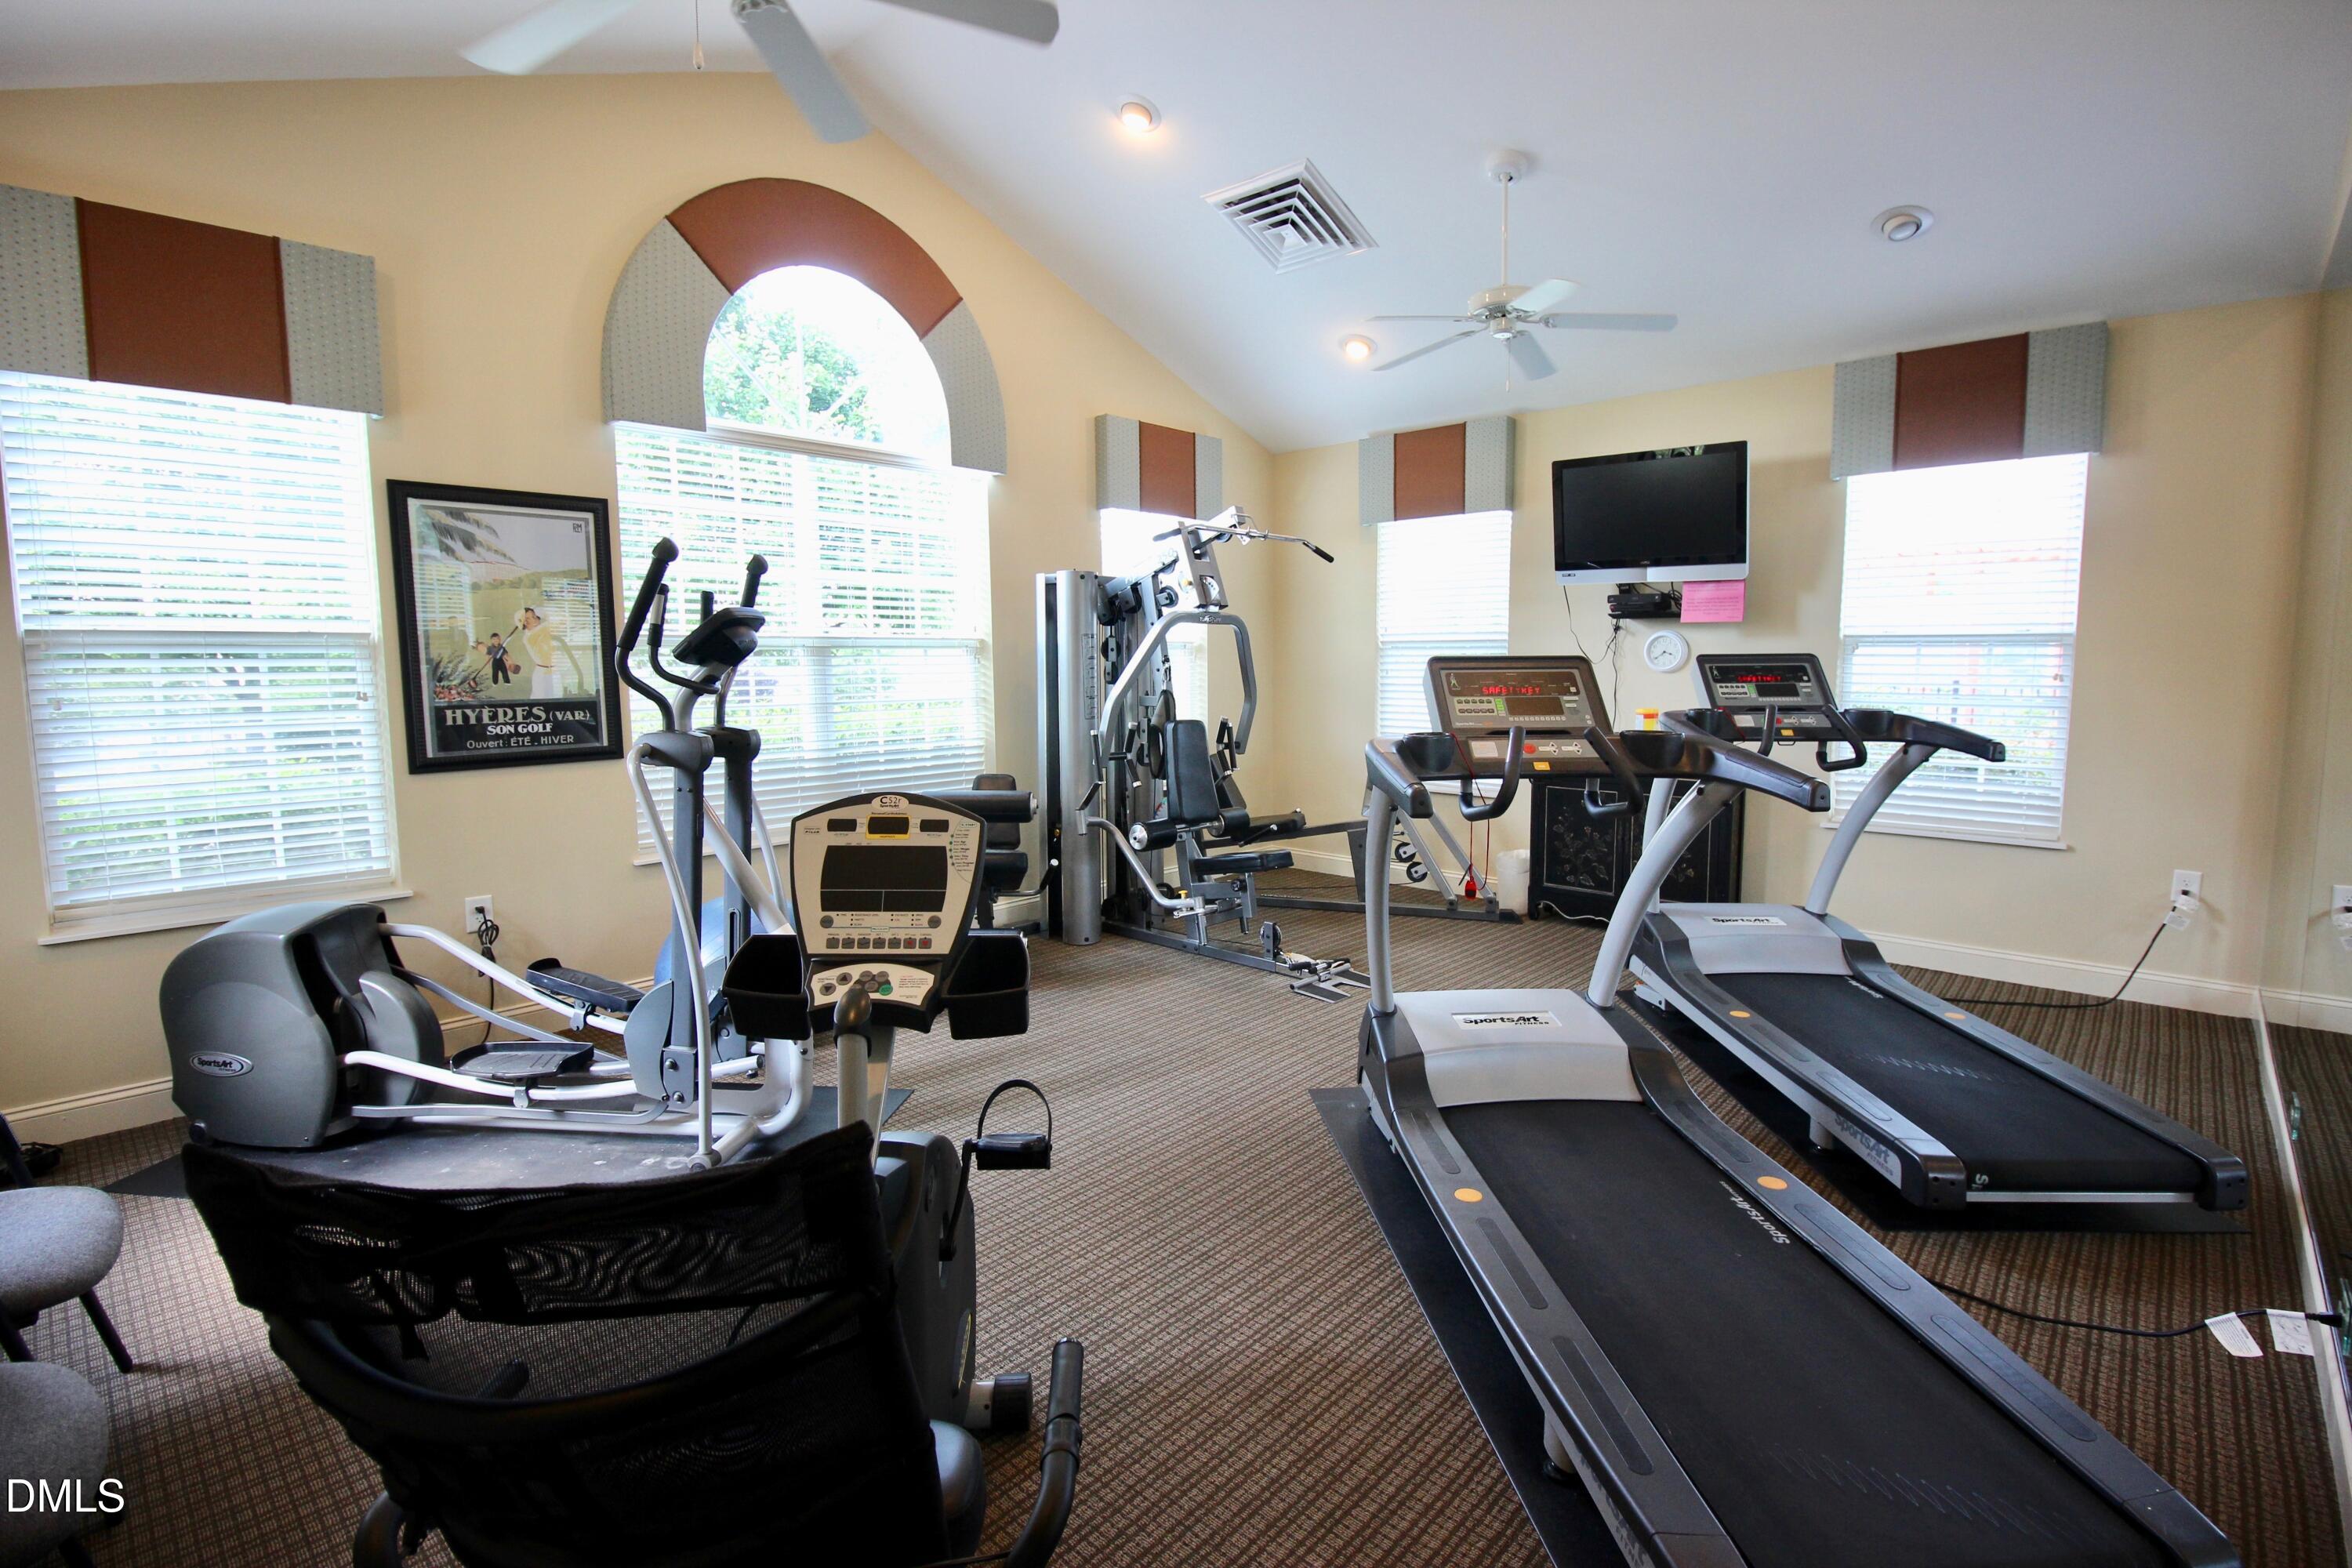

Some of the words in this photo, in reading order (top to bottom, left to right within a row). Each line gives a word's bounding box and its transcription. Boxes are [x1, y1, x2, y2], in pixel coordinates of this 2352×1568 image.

[445, 706, 547, 726] HYÈRES
[550, 709, 590, 721] (VAR)
[486, 724, 515, 735] SON
[517, 722, 554, 733] GOLF
[510, 735, 532, 746] ÉTÉ
[541, 735, 574, 745] HIVER
[880, 796, 902, 804] C52r
[1463, 1016, 1540, 1025] SportsArt
[197, 1057, 233, 1068] SportsArt
[1835, 1114, 1889, 1163] SportsArt
[1730, 1196, 1791, 1244] SportsArt
